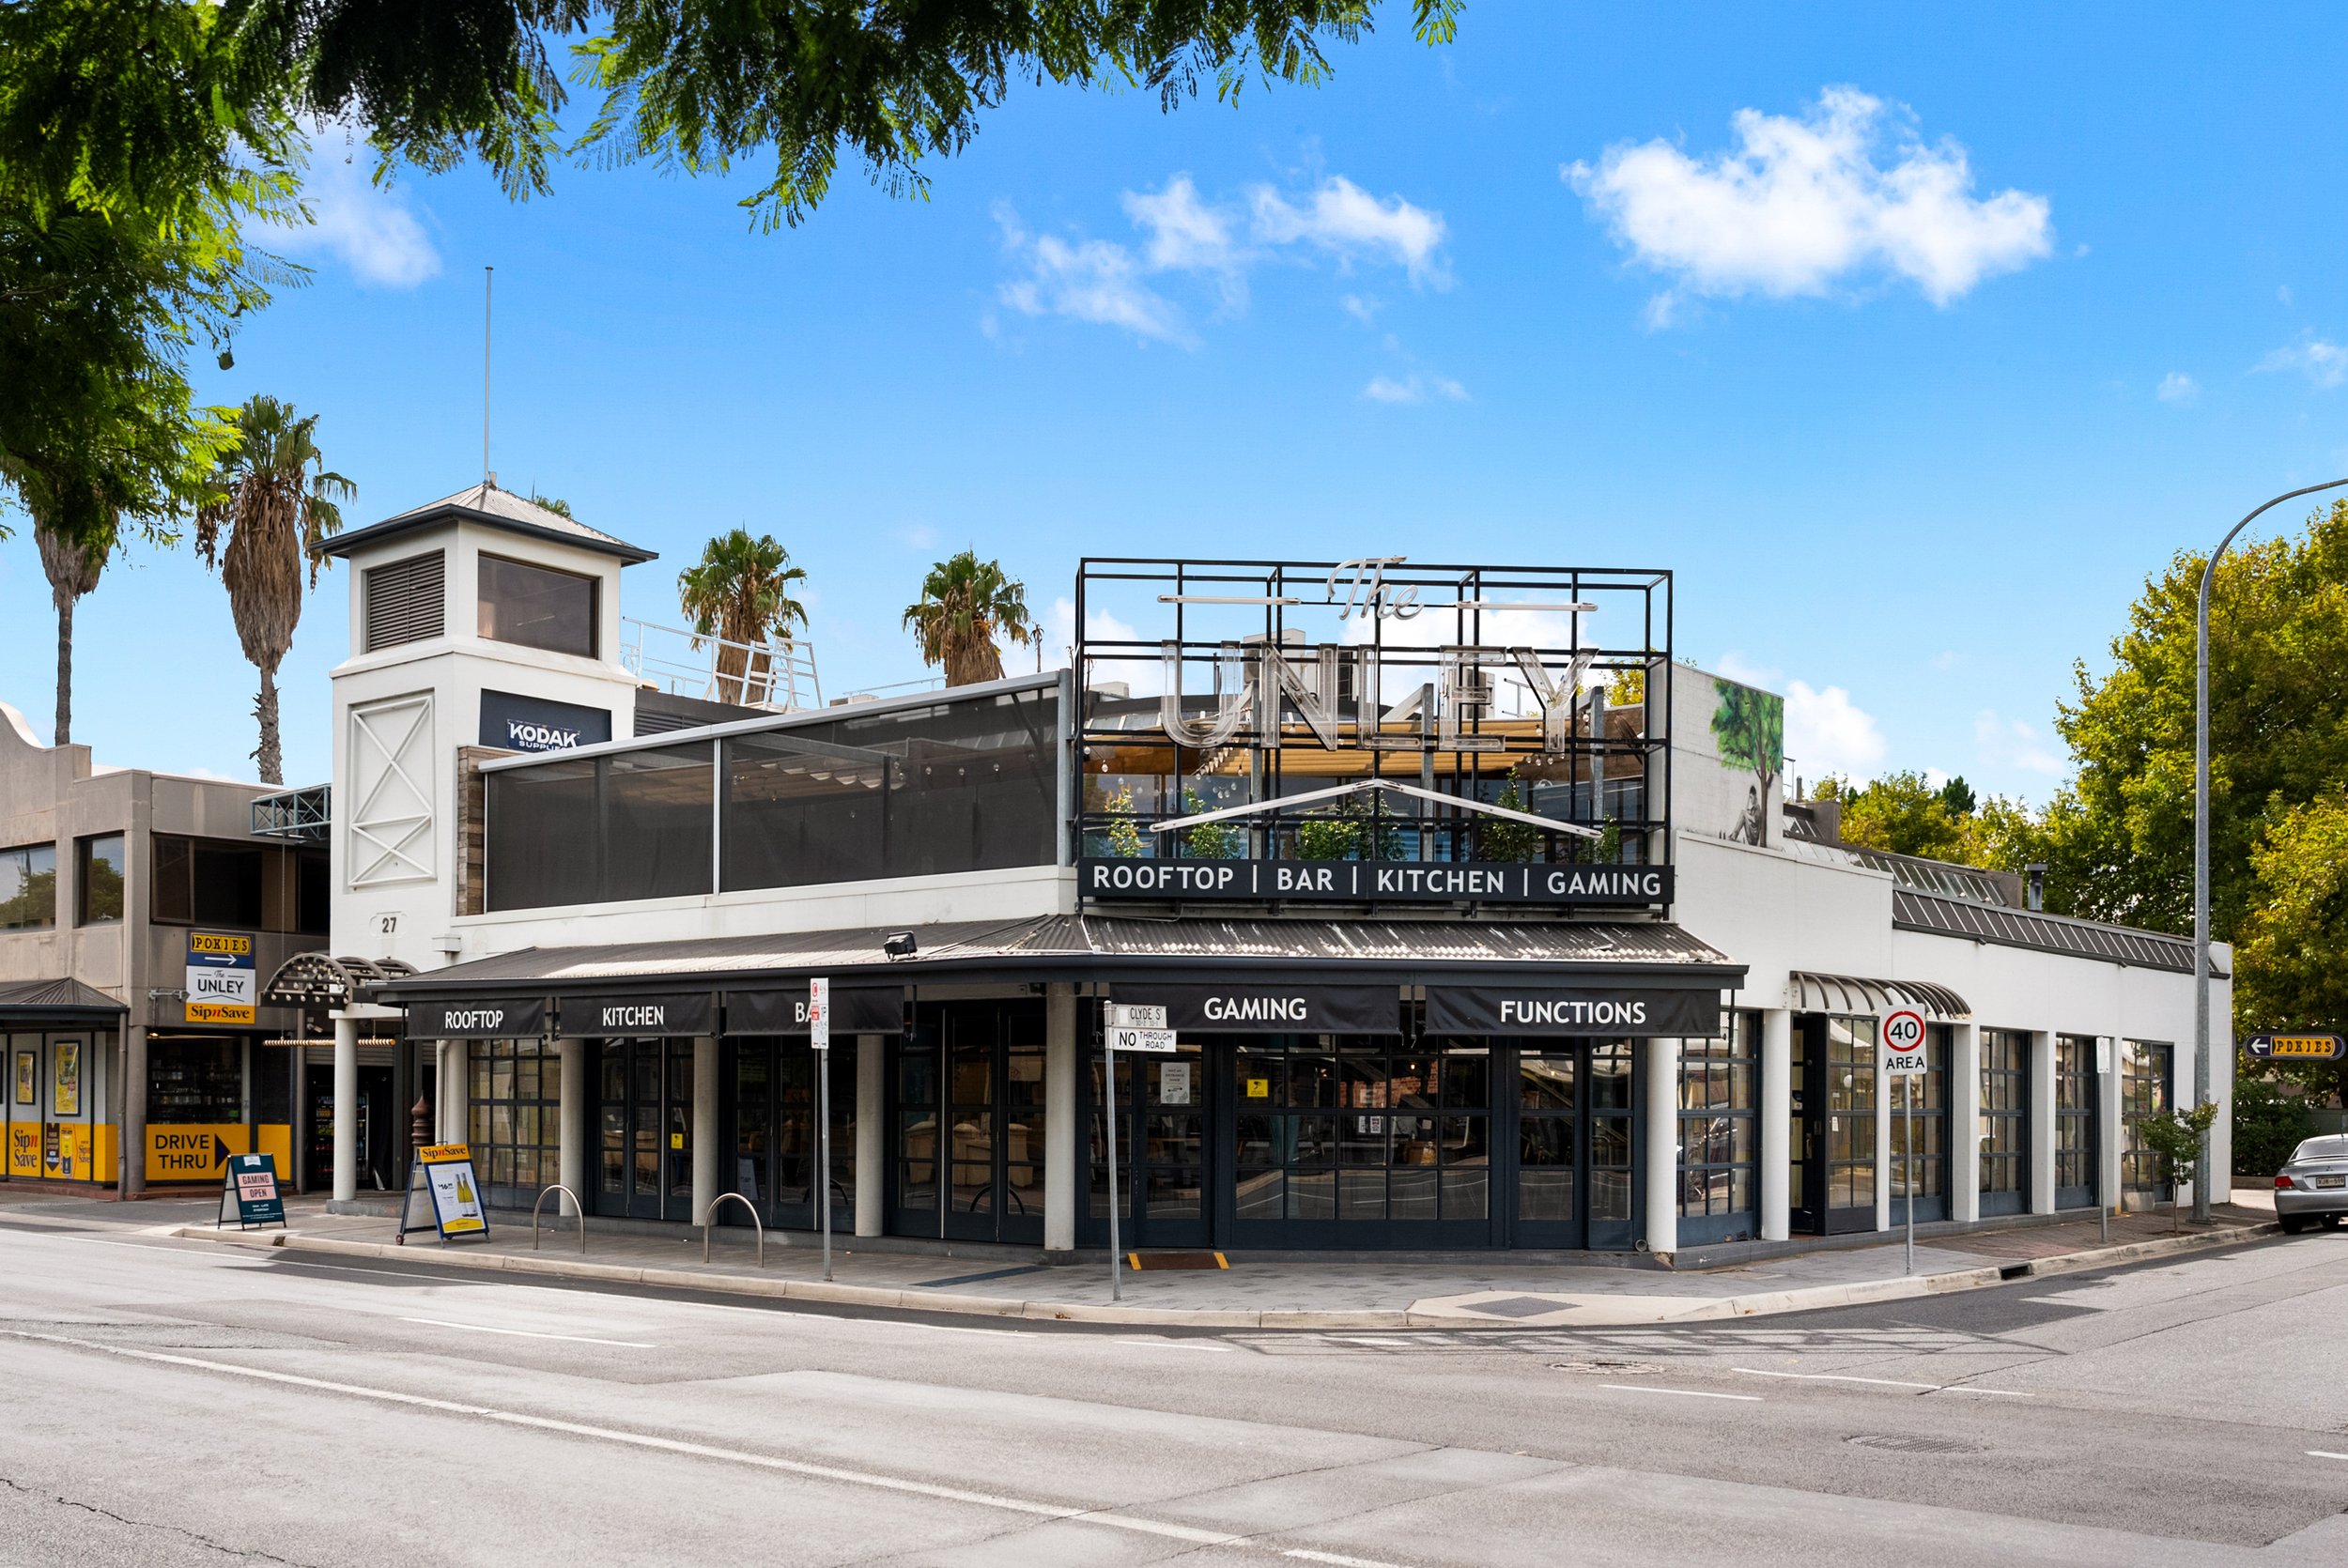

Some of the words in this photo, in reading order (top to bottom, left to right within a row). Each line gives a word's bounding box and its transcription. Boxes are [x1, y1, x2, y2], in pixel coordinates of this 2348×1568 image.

[1327, 556, 1425, 621] The
[1161, 639, 1599, 752] UNLEY
[510, 723, 579, 748] KODAK
[1093, 866, 1234, 889] ROOFTOP
[1277, 869, 1334, 891] BAR
[1378, 869, 1504, 893] KITCHEN
[1548, 872, 1661, 895] GAMING
[382, 916, 396, 933] 27
[194, 937, 248, 952] POKIES
[197, 978, 244, 993] UNLEY
[602, 1006, 665, 1026] KITCHEN
[1130, 1007, 1152, 1021] CLYDE
[1204, 997, 1307, 1020] GAMING
[1501, 1001, 1646, 1024] FUNCTIONS
[444, 1010, 504, 1029] ROOFTOP
[1119, 1032, 1136, 1047] NO
[1139, 1031, 1172, 1041] THROUGH
[1890, 1022, 1917, 1040] 40
[1146, 1040, 1166, 1050] ROAD
[2276, 1040, 2331, 1053] POKIES
[1886, 1056, 1925, 1069] AREA
[155, 1134, 209, 1150] DRIVE
[14, 1149, 38, 1167] Save
[159, 1154, 207, 1170] THRU
[242, 1175, 270, 1184] GAMING
[250, 1189, 267, 1198] OPEN
